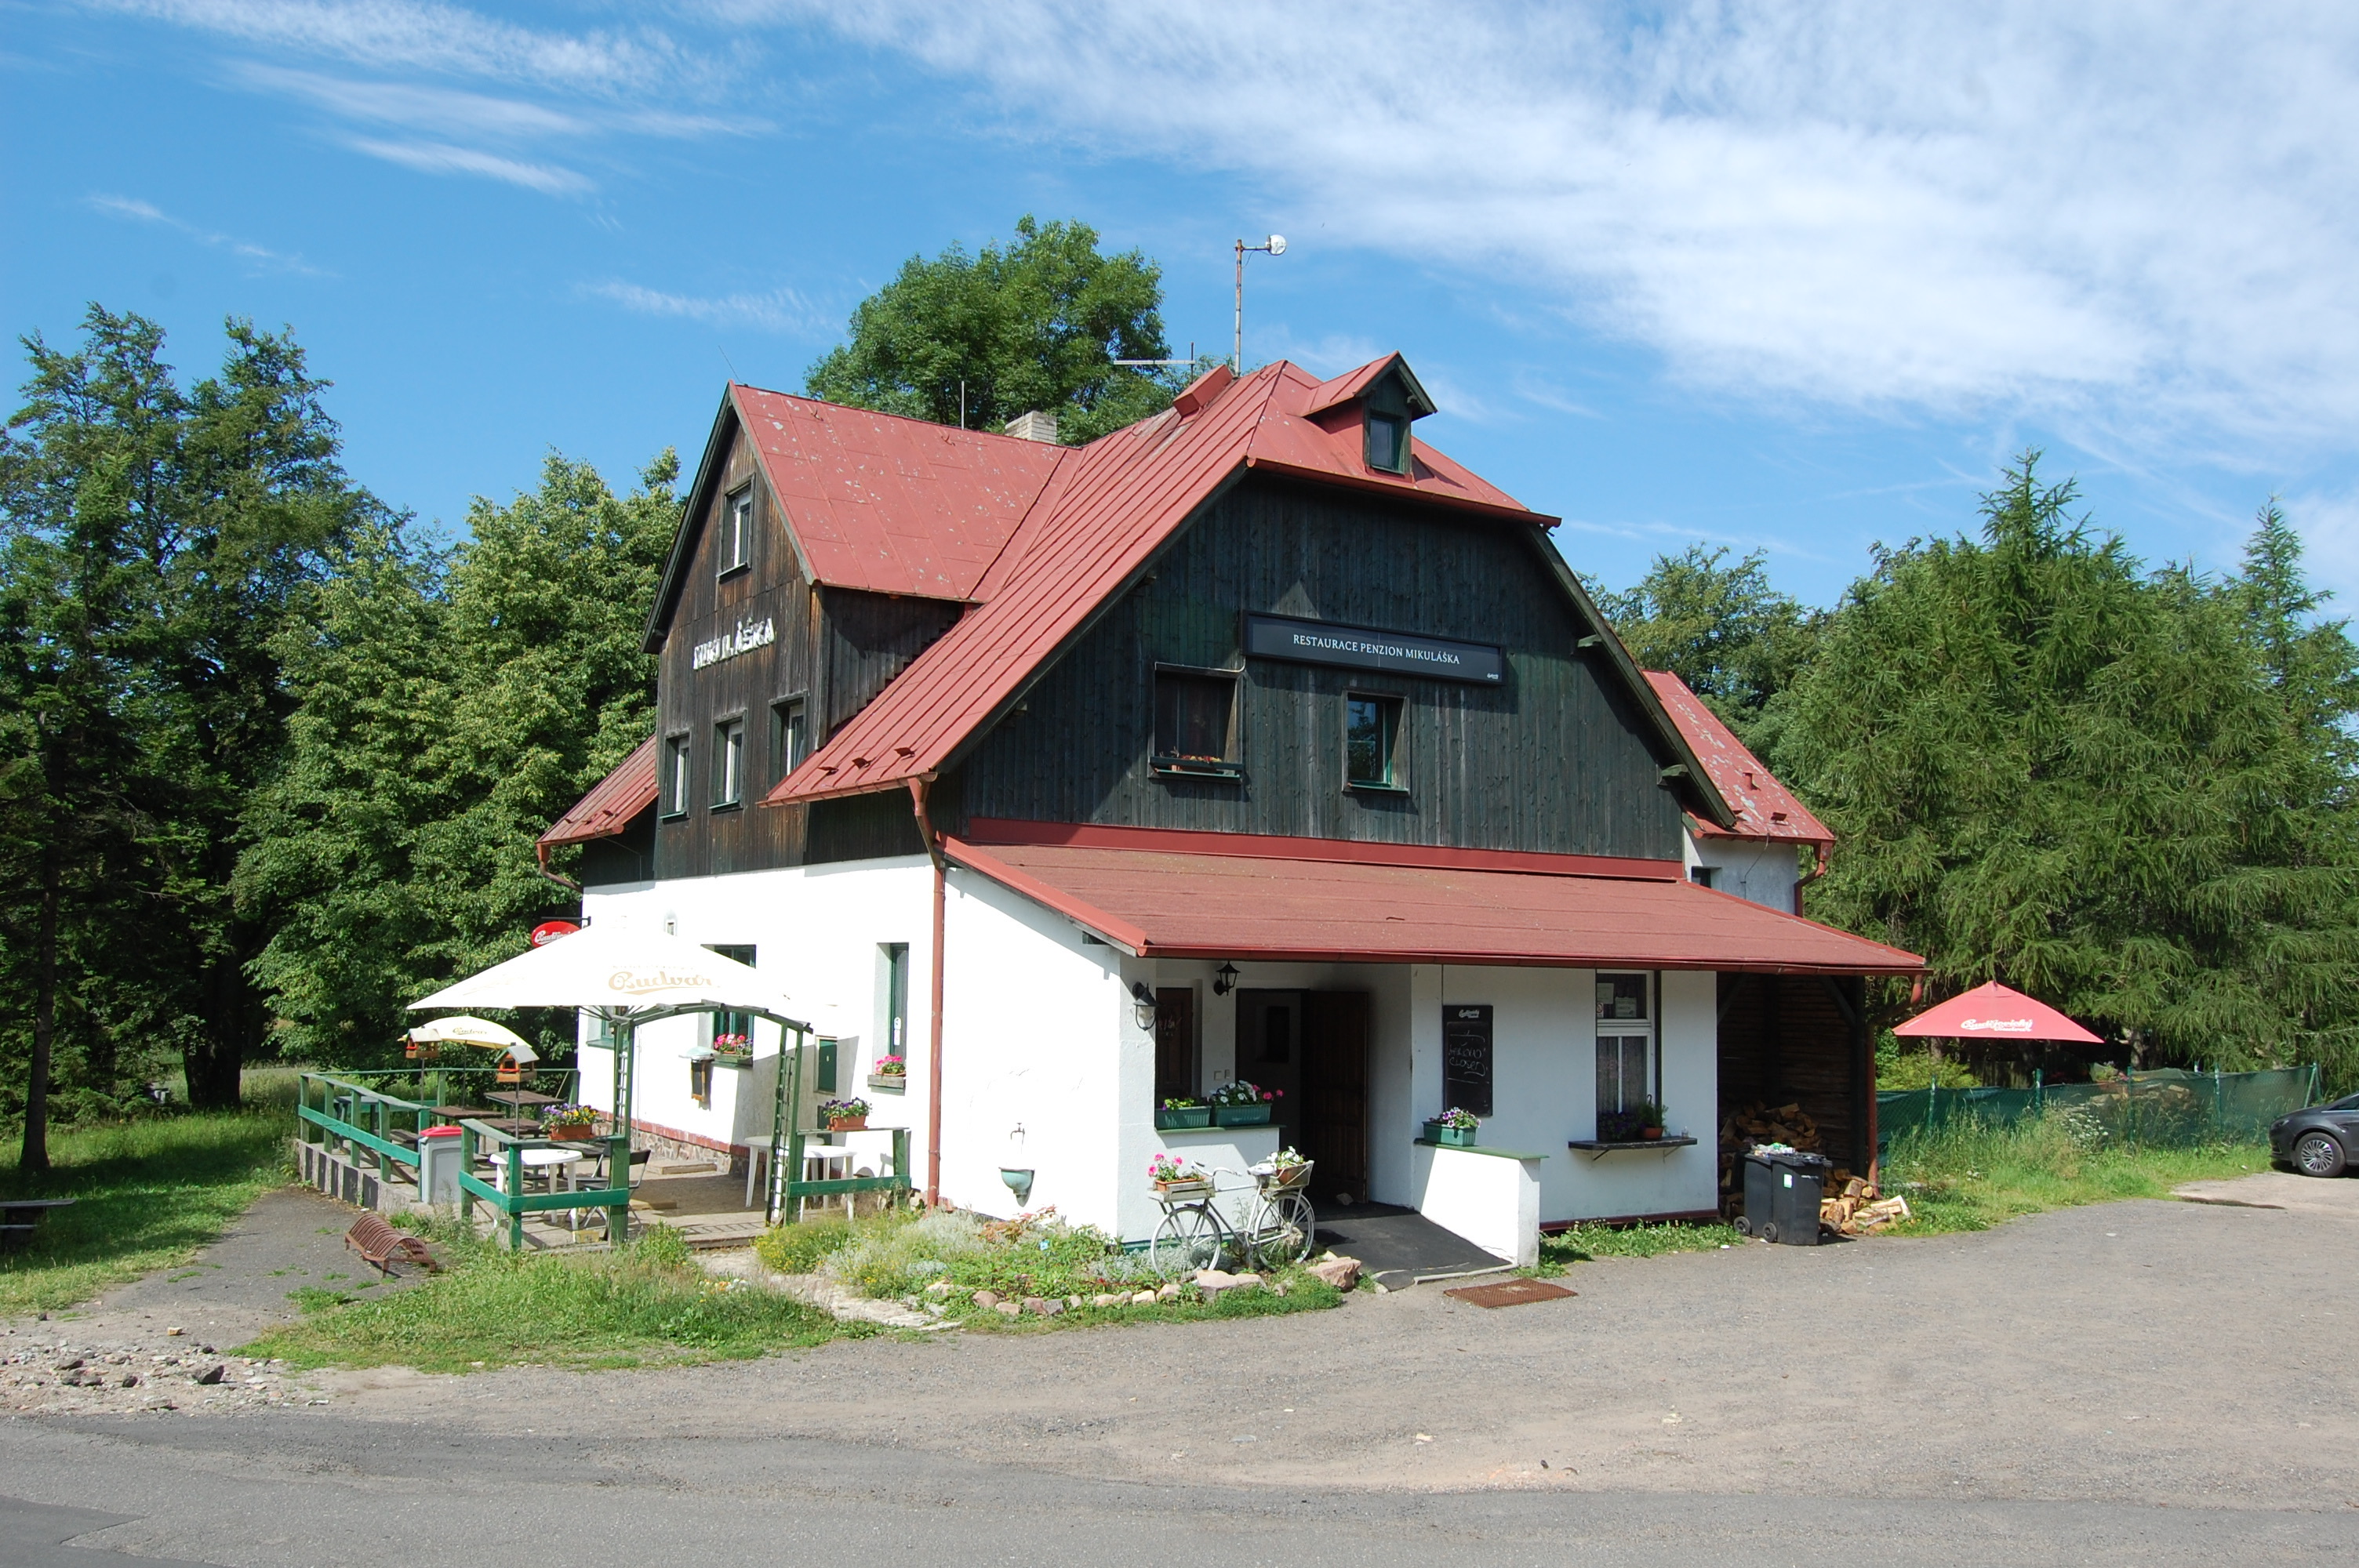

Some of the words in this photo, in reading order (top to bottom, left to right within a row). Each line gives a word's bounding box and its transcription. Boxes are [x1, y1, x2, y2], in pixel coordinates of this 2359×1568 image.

[1293, 633, 1358, 652] RESTAURACE
[1360, 642, 1403, 657] PENZION
[1405, 648, 1460, 665] MIKULÁŠKA
[609, 971, 714, 995] Budvar
